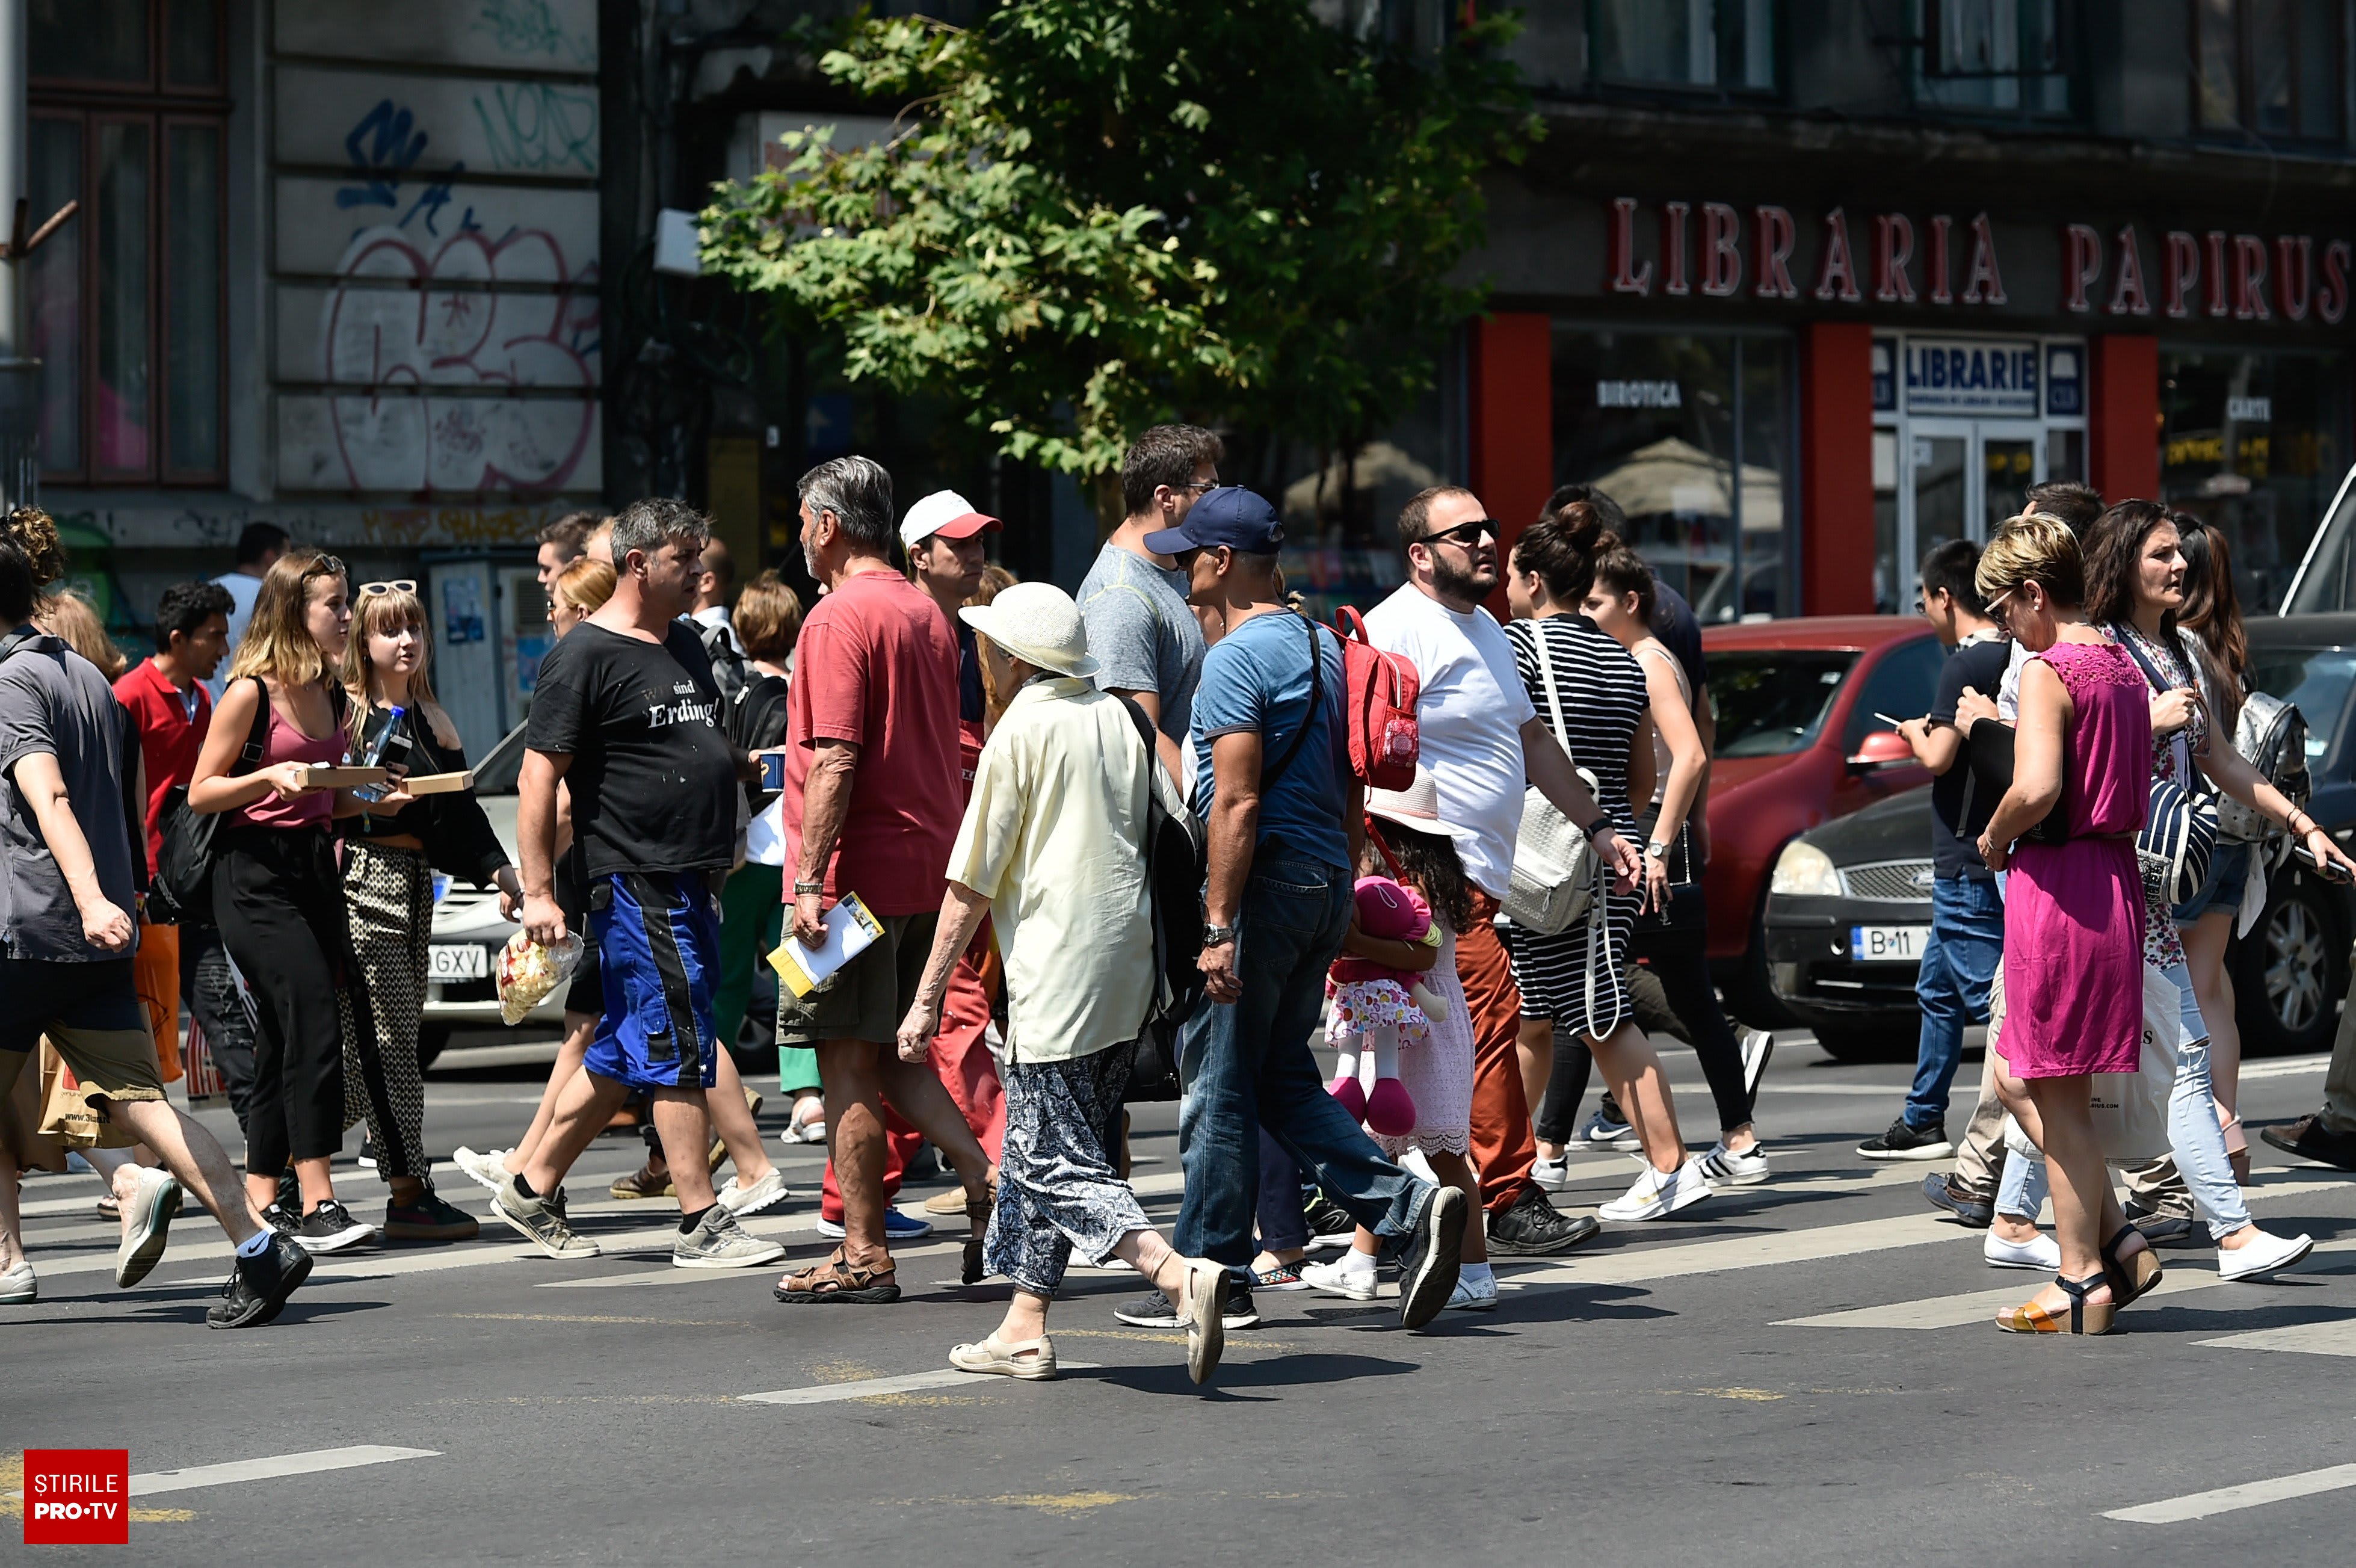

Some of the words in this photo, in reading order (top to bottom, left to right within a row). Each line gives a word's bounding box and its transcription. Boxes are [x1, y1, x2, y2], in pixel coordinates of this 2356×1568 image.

[1608, 196, 2008, 306] LIBRARIA
[2064, 223, 2351, 325] PAPIRUS
[1906, 345, 2036, 389] LIBRARIE
[673, 679, 695, 695] sind
[648, 697, 720, 728] Erding!
[1872, 931, 1886, 954] B
[2140, 1030, 2153, 1045] S
